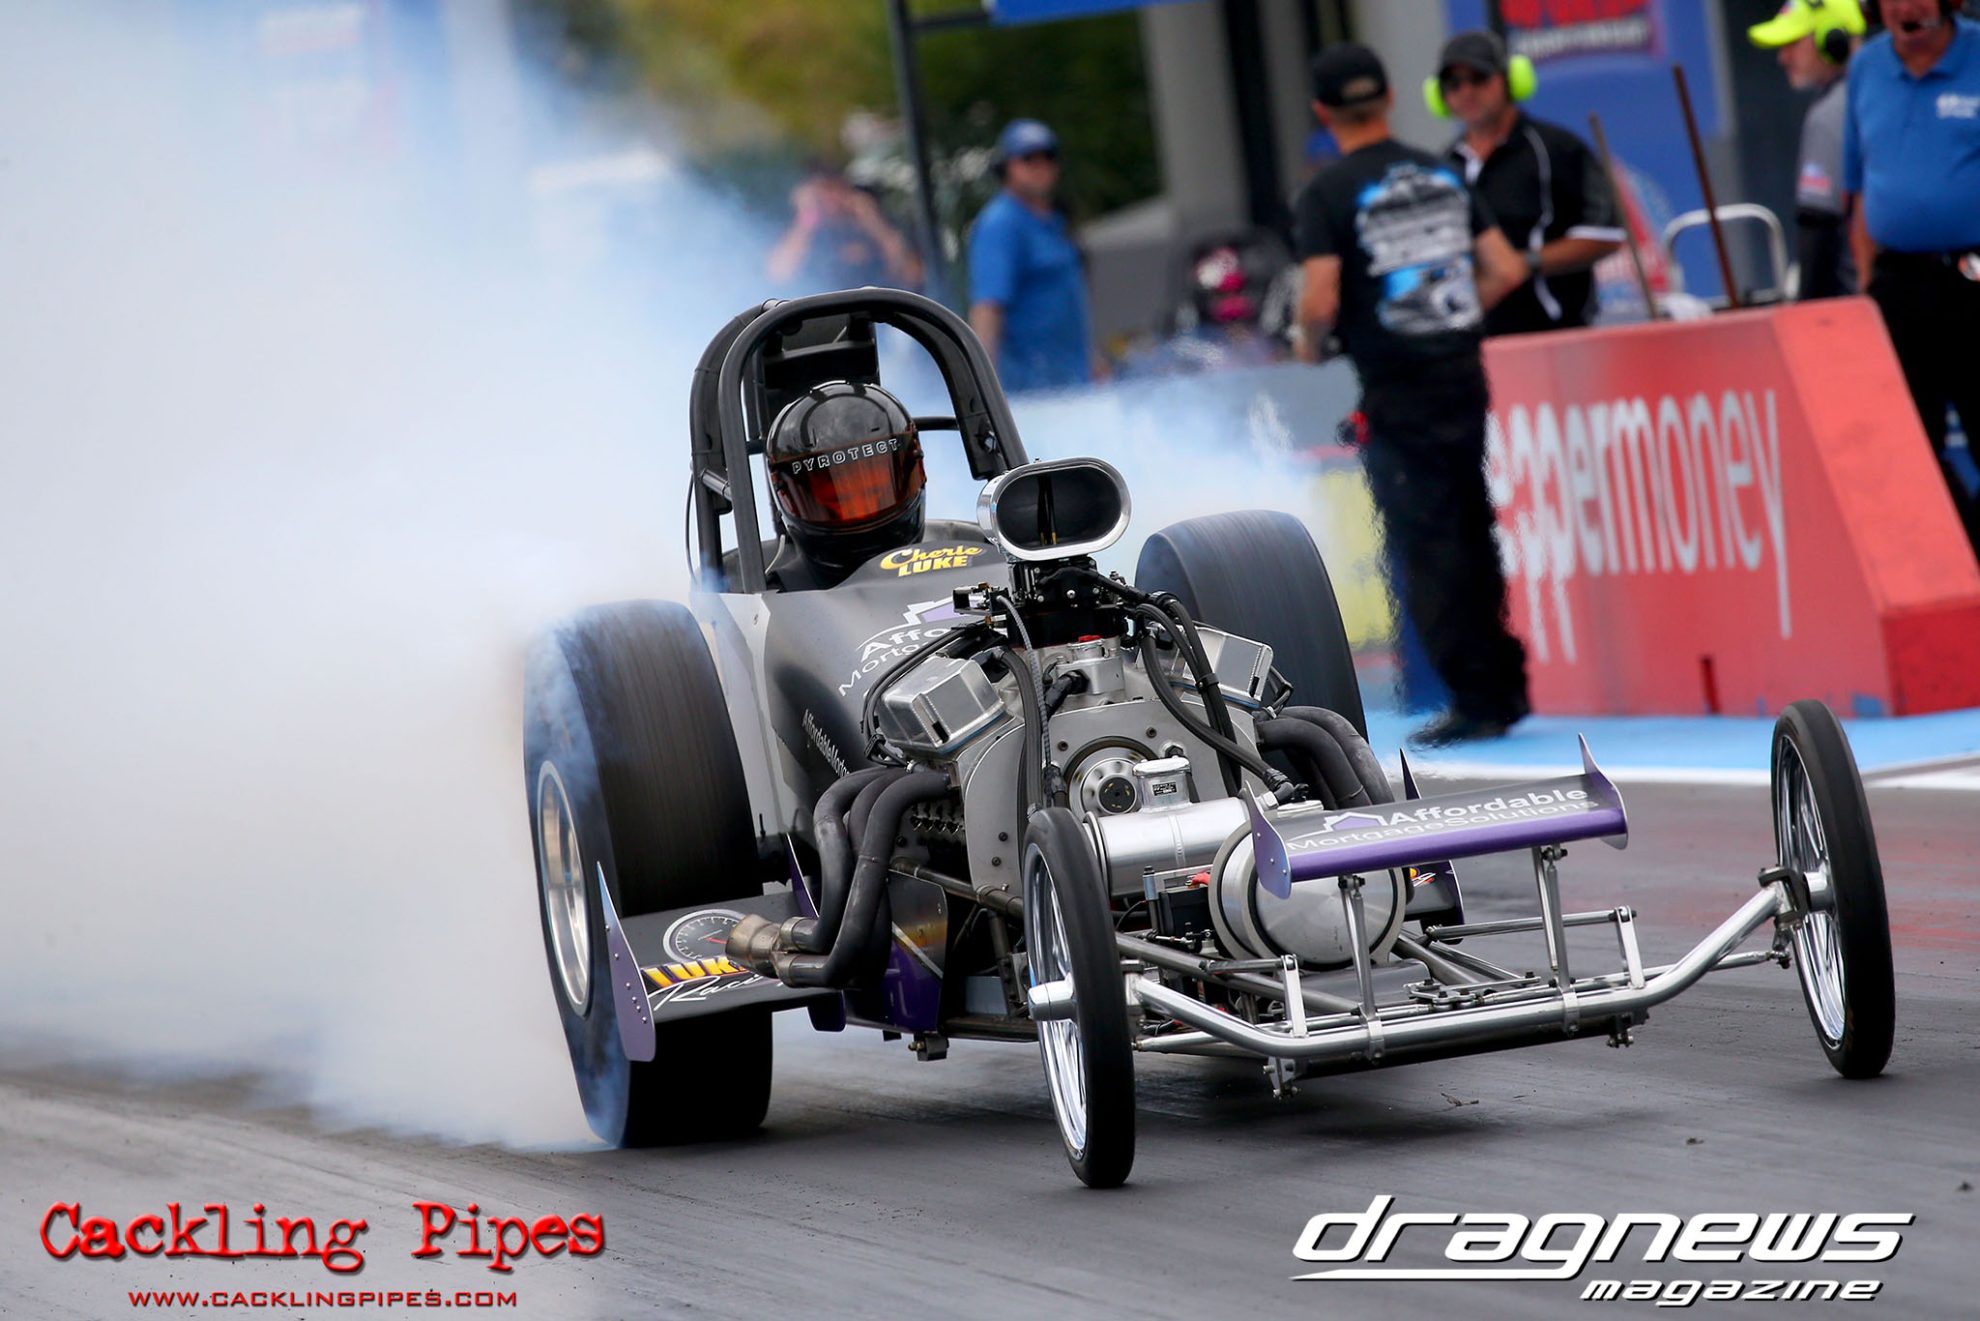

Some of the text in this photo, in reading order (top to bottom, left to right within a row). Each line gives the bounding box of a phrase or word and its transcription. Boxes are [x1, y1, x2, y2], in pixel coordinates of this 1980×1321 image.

[792, 439, 897, 475] PYROTECT
[1482, 388, 1792, 662] eppermoney
[880, 545, 983, 570] Cherie
[898, 556, 969, 577] LUKE
[861, 628, 951, 662] Affo
[839, 641, 929, 697] Mortg
[1390, 790, 1588, 826] Affordable
[643, 956, 750, 989] LUK
